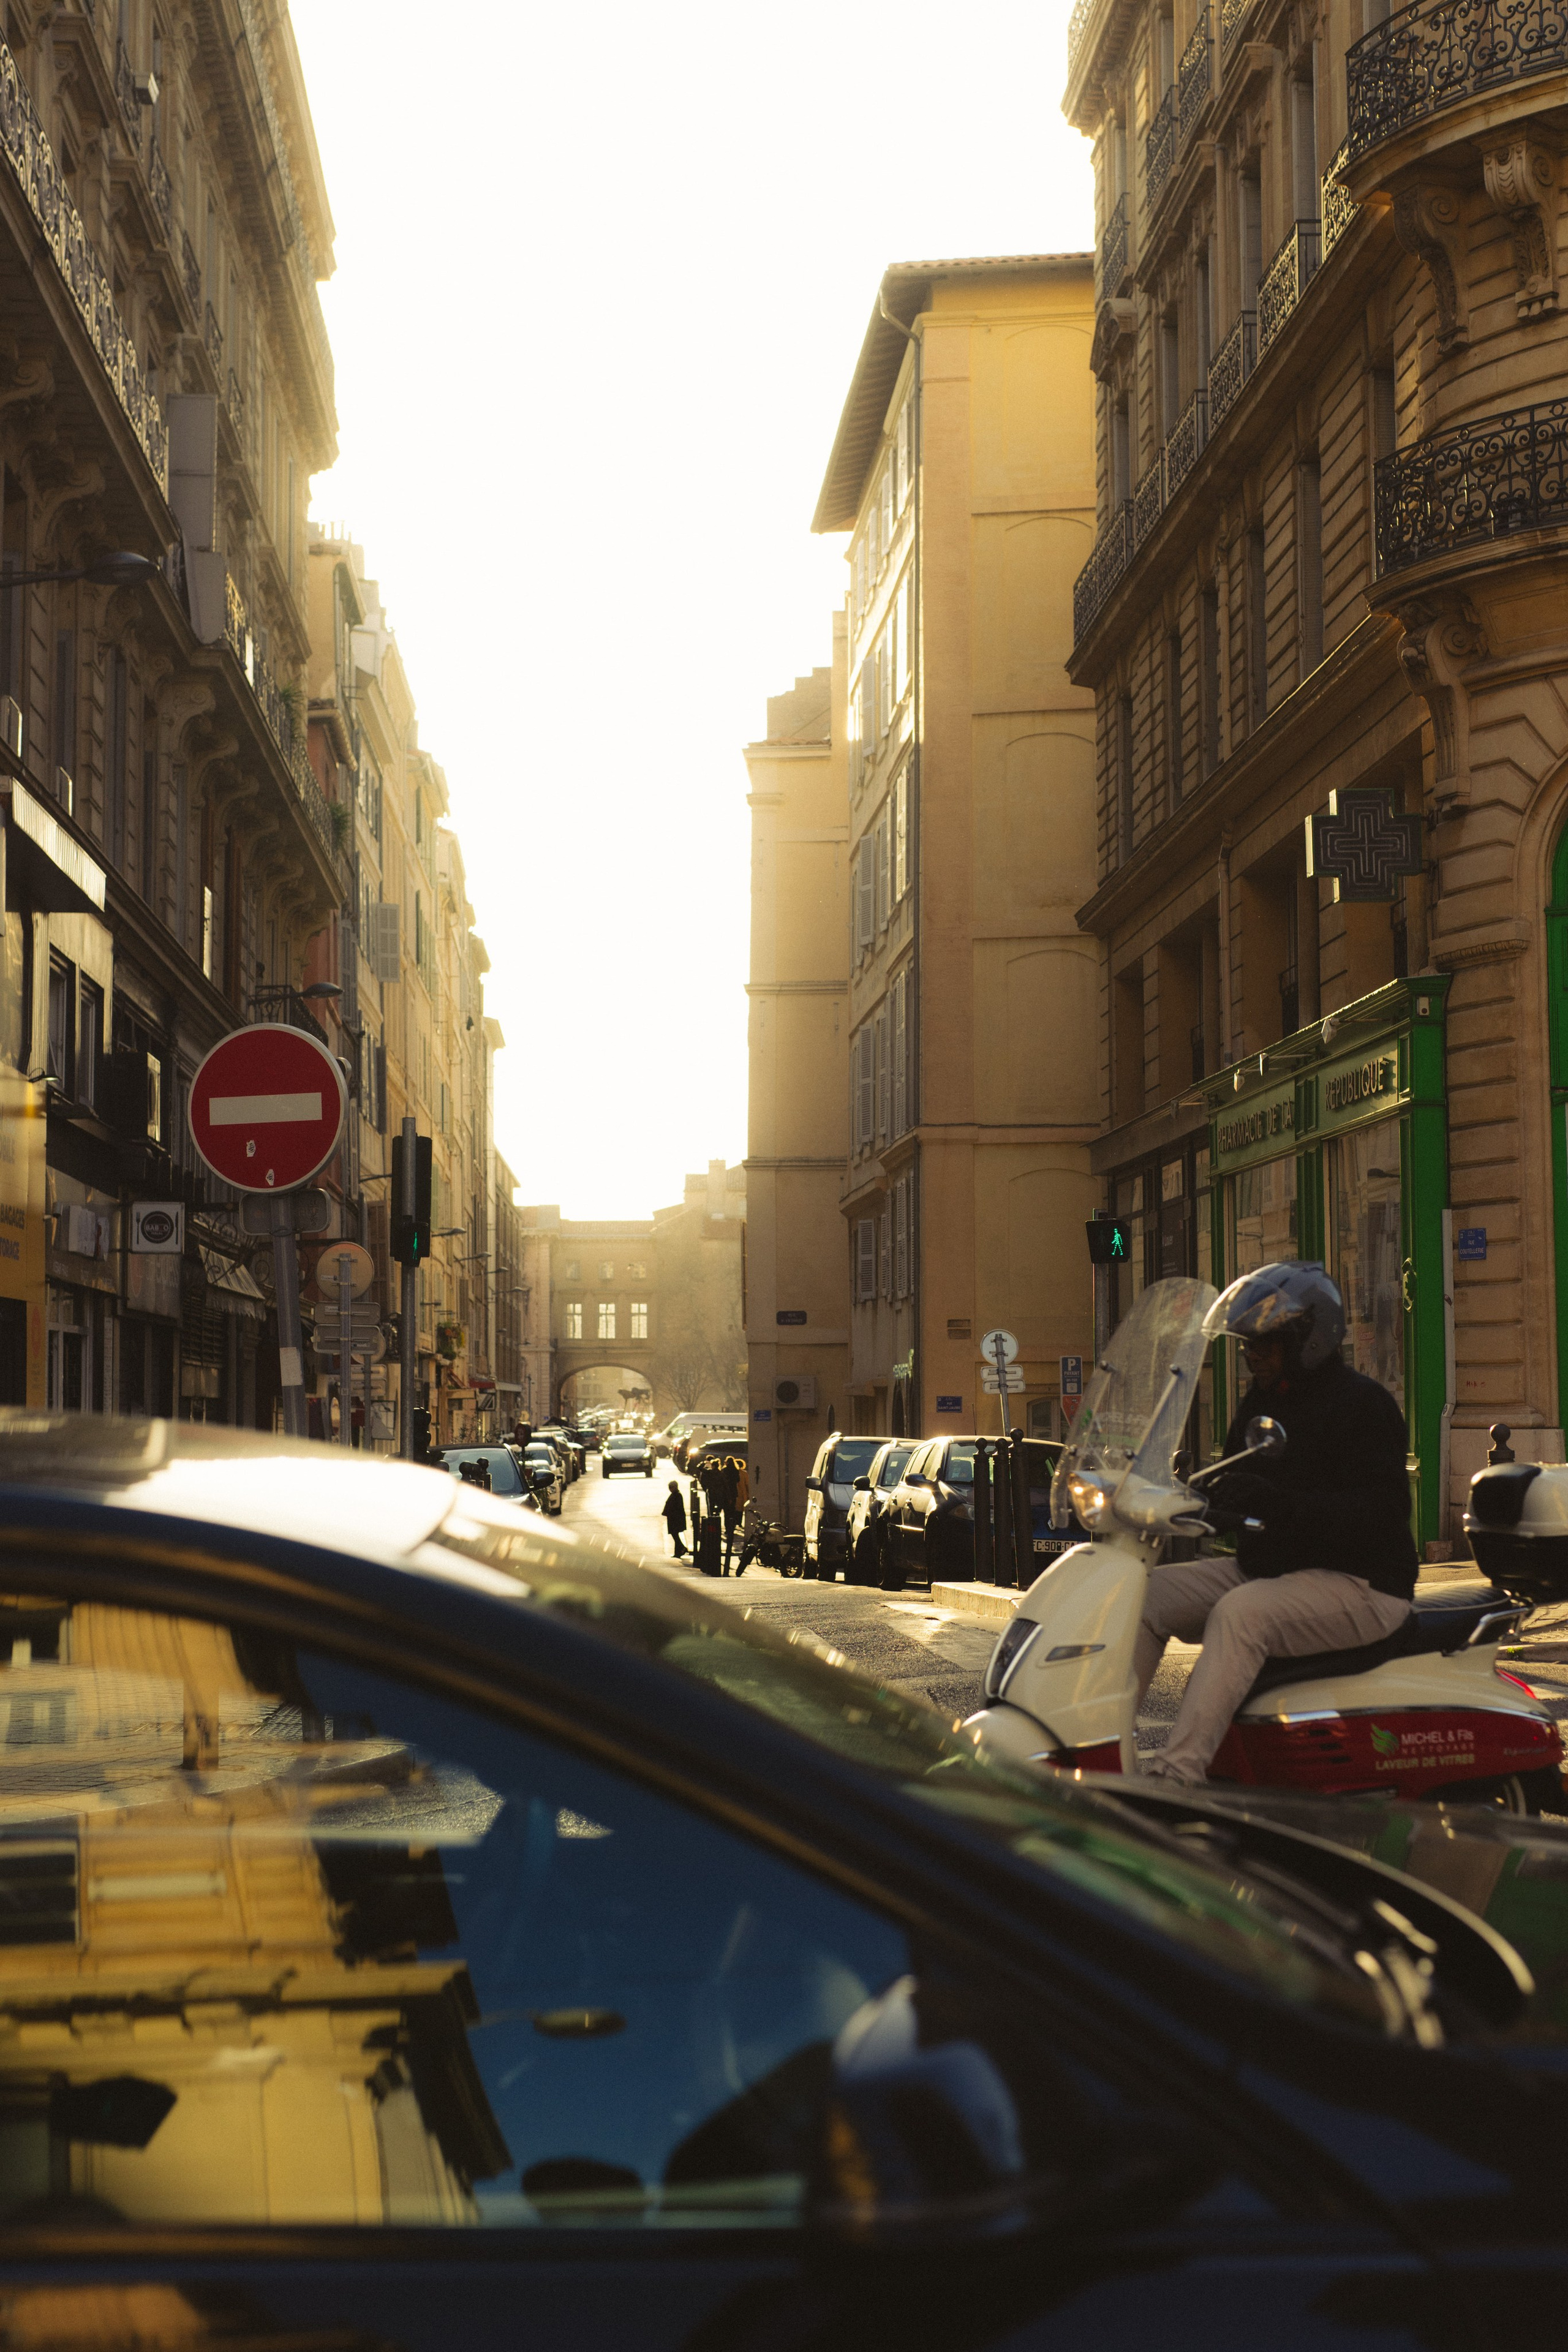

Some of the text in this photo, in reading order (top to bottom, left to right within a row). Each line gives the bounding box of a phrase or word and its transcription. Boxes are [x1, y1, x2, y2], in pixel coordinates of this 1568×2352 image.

[1218, 1111, 1262, 1154] PHARMACIE
[1267, 1104, 1277, 1134] DE
[1282, 1096, 1295, 1129] LA
[1068, 1358, 1076, 1371] P
[1401, 1731, 1445, 1745] MICHEL
[1447, 1730, 1455, 1742] &
[1375, 1754, 1475, 1771] LAVEUR DE VITRES
